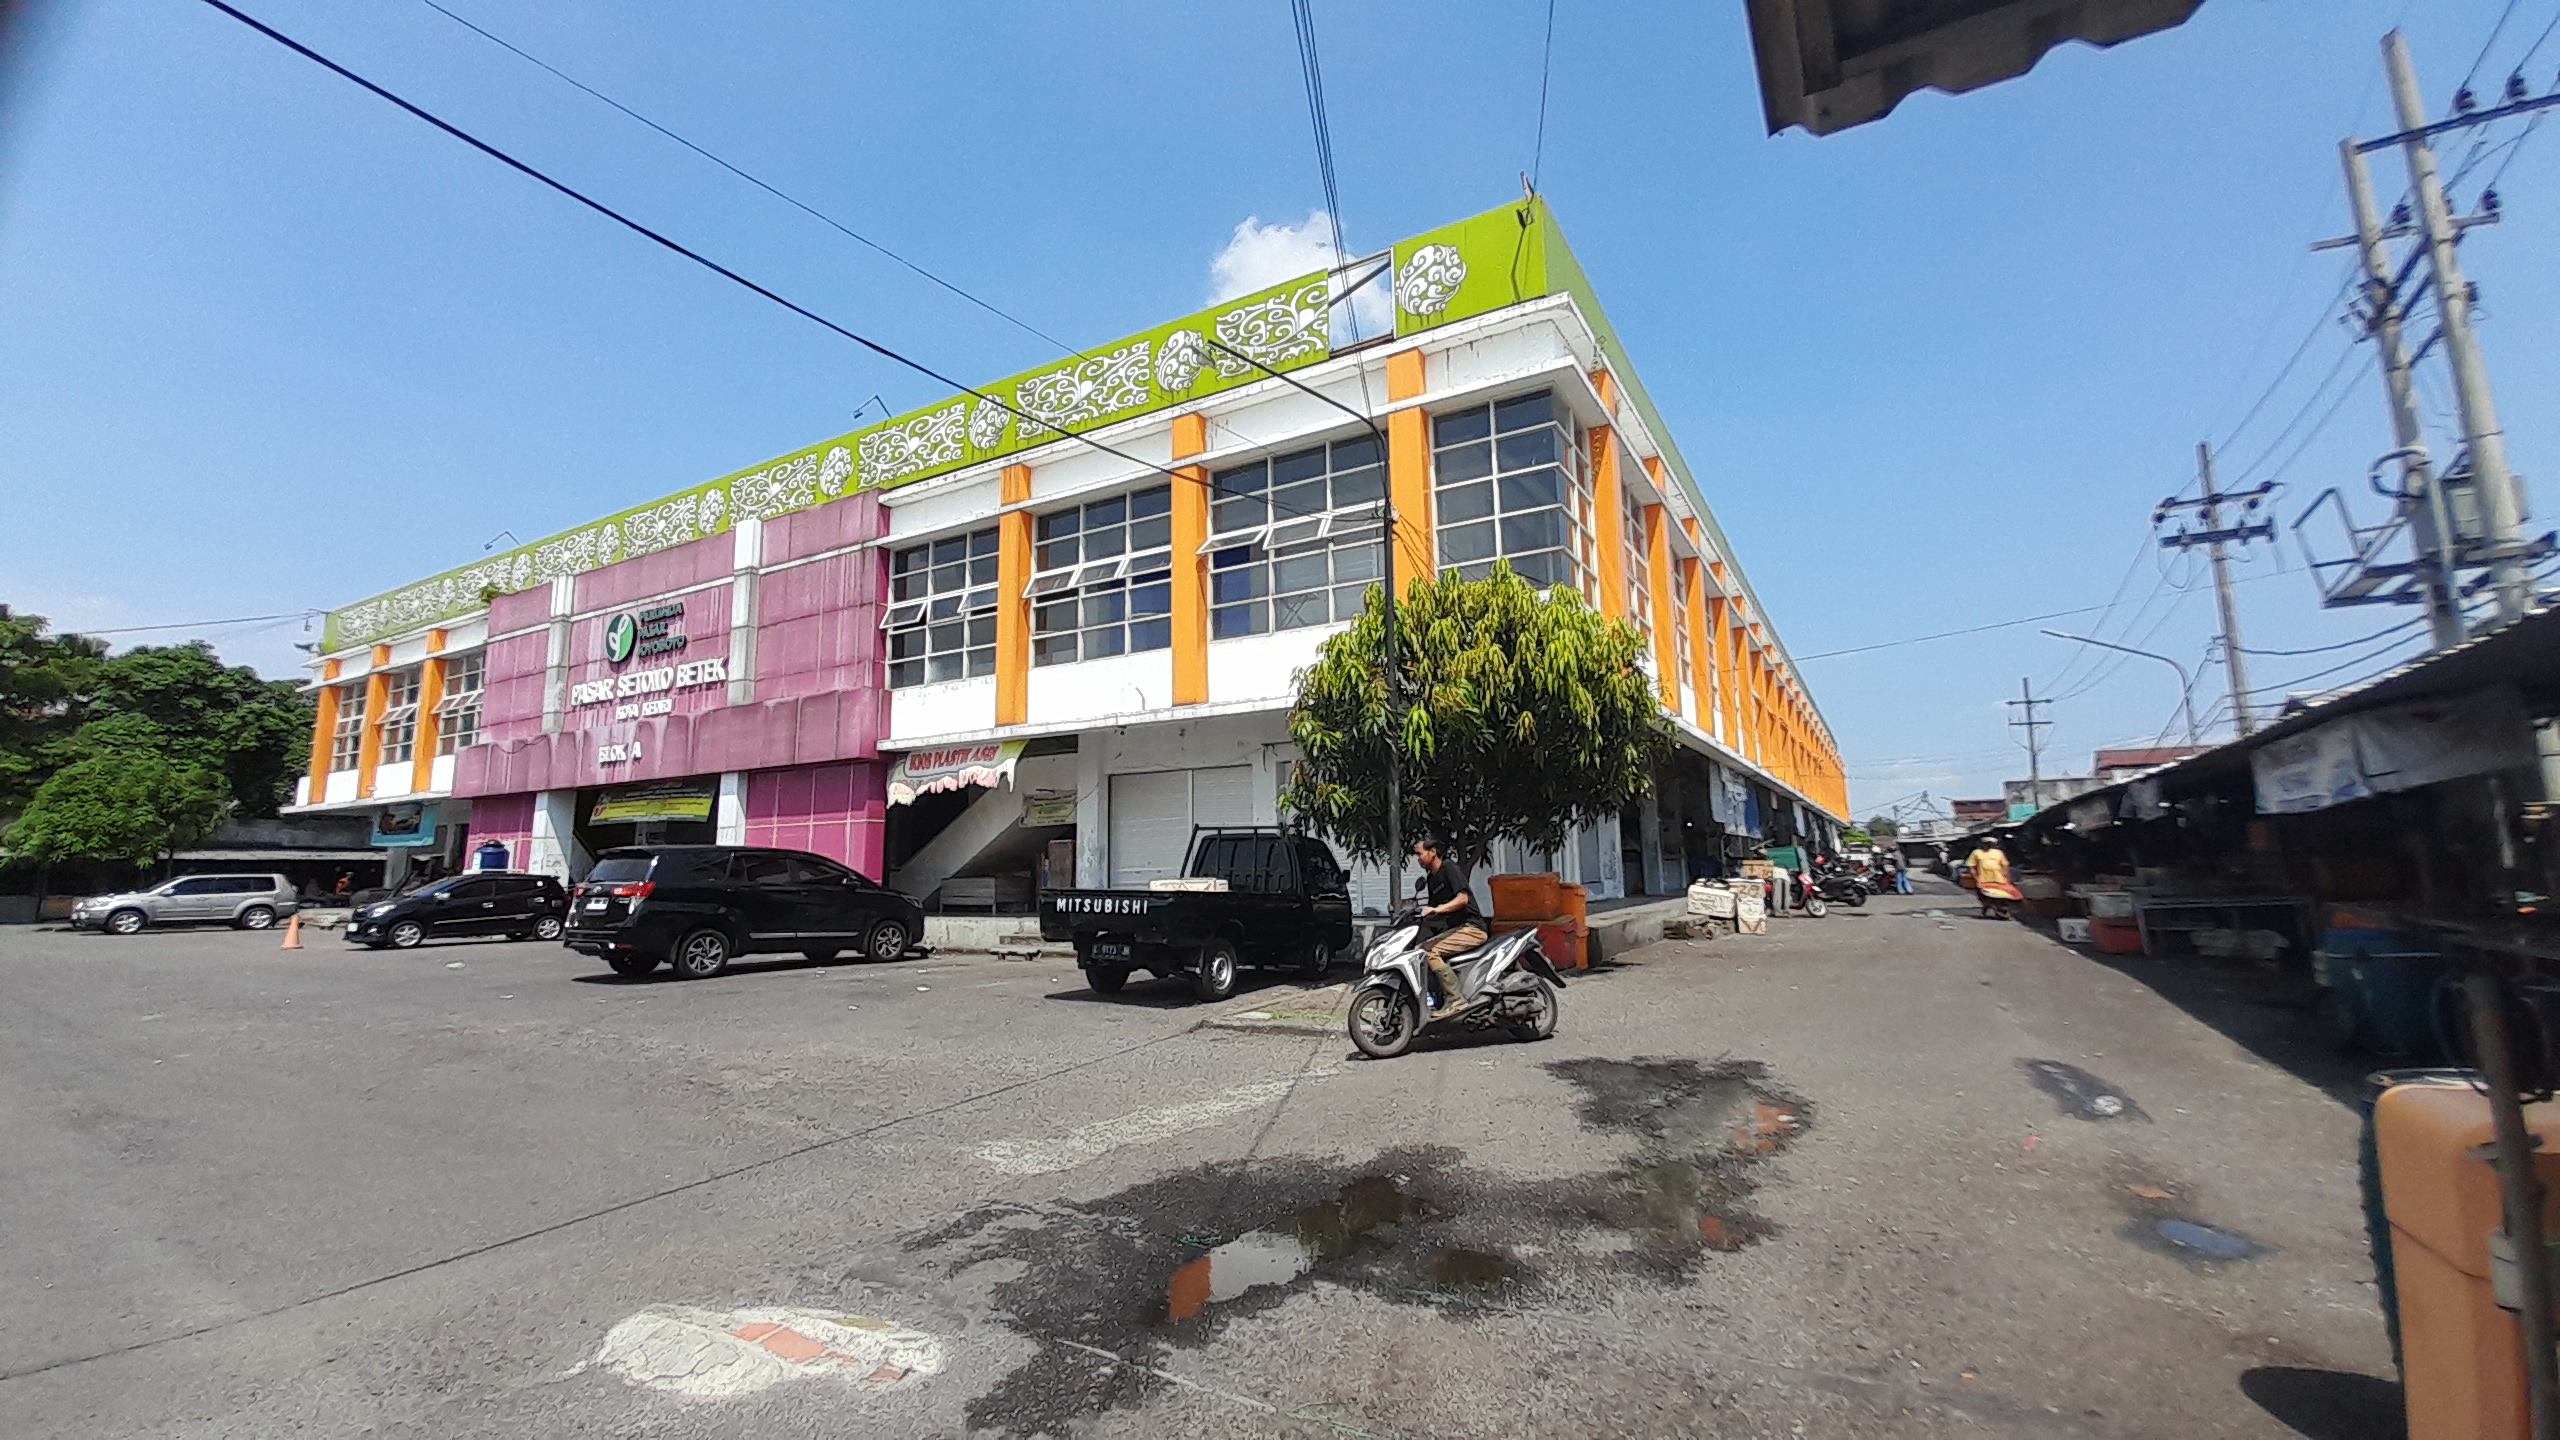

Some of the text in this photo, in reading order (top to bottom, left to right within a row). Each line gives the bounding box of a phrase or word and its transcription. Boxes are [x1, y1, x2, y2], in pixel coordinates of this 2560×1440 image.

[571, 678, 615, 706] PASAR
[675, 657, 727, 688] BETEK
[598, 741, 642, 763] BLOK A
[932, 747, 973, 769] PLASTIK
[1056, 898, 1148, 914] MITSUBISHI
